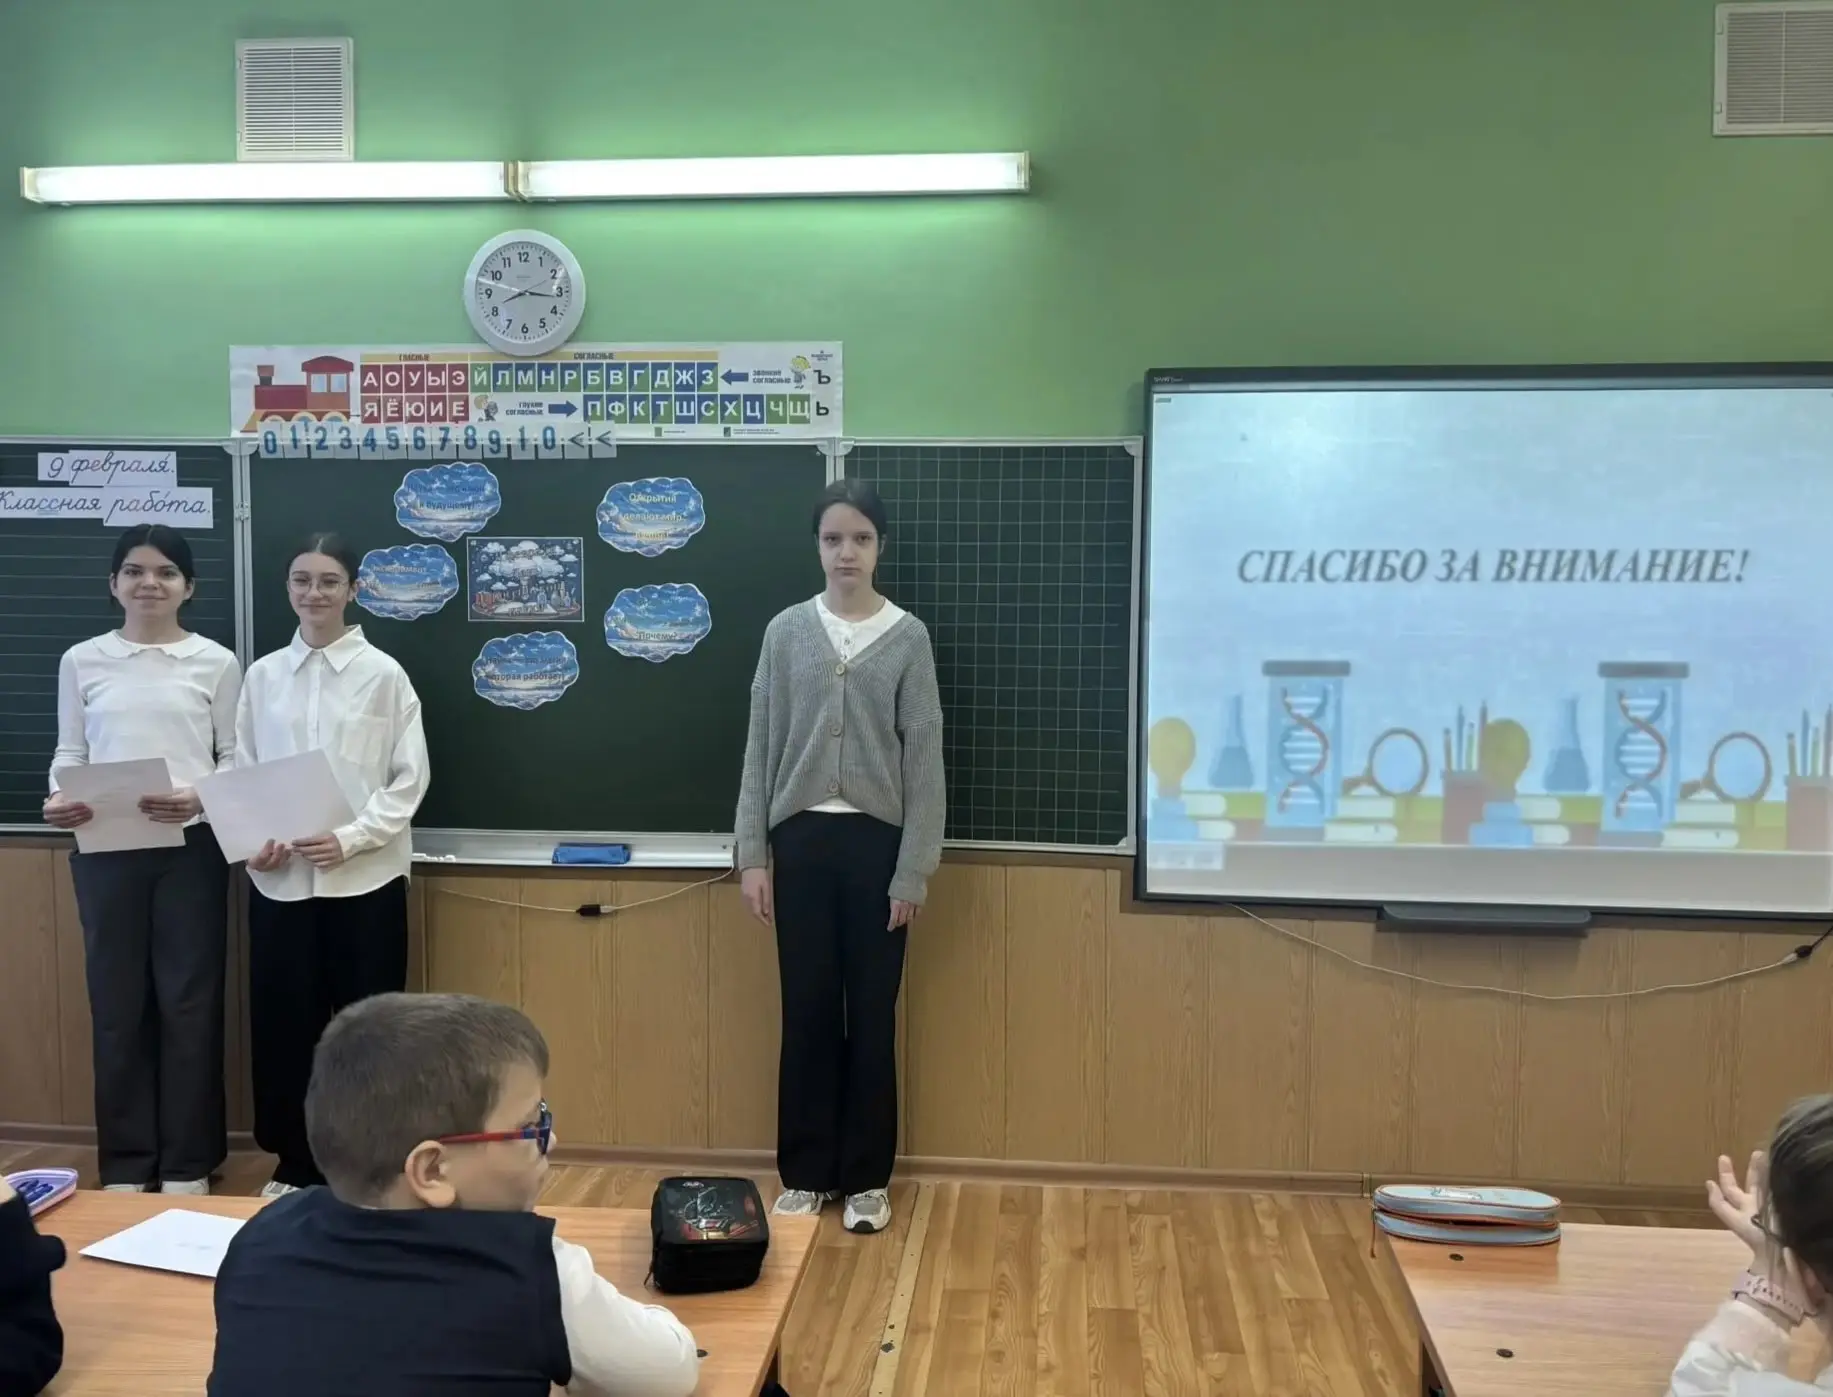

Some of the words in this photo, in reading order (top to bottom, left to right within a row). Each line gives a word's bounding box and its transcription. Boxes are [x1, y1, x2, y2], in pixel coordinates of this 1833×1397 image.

[502, 257, 511, 268] 11
[518, 252, 529, 263] 12
[538, 256, 543, 267] 1
[490, 270, 502, 281] 10
[550, 269, 557, 280] 2
[485, 288, 492, 299] 9
[556, 287, 563, 297] 3
[491, 306, 499, 317] 8
[550, 306, 557, 315] 4
[506, 319, 512, 330] 7
[521, 323, 528, 334] 6
[539, 318, 546, 328] 5
[48, 457, 64, 478] 9
[1237, 548, 1428, 584] СПАСИБО
[1434, 549, 1480, 584] ЗА
[1491, 548, 1751, 584] ВНИМАНИЕ!
